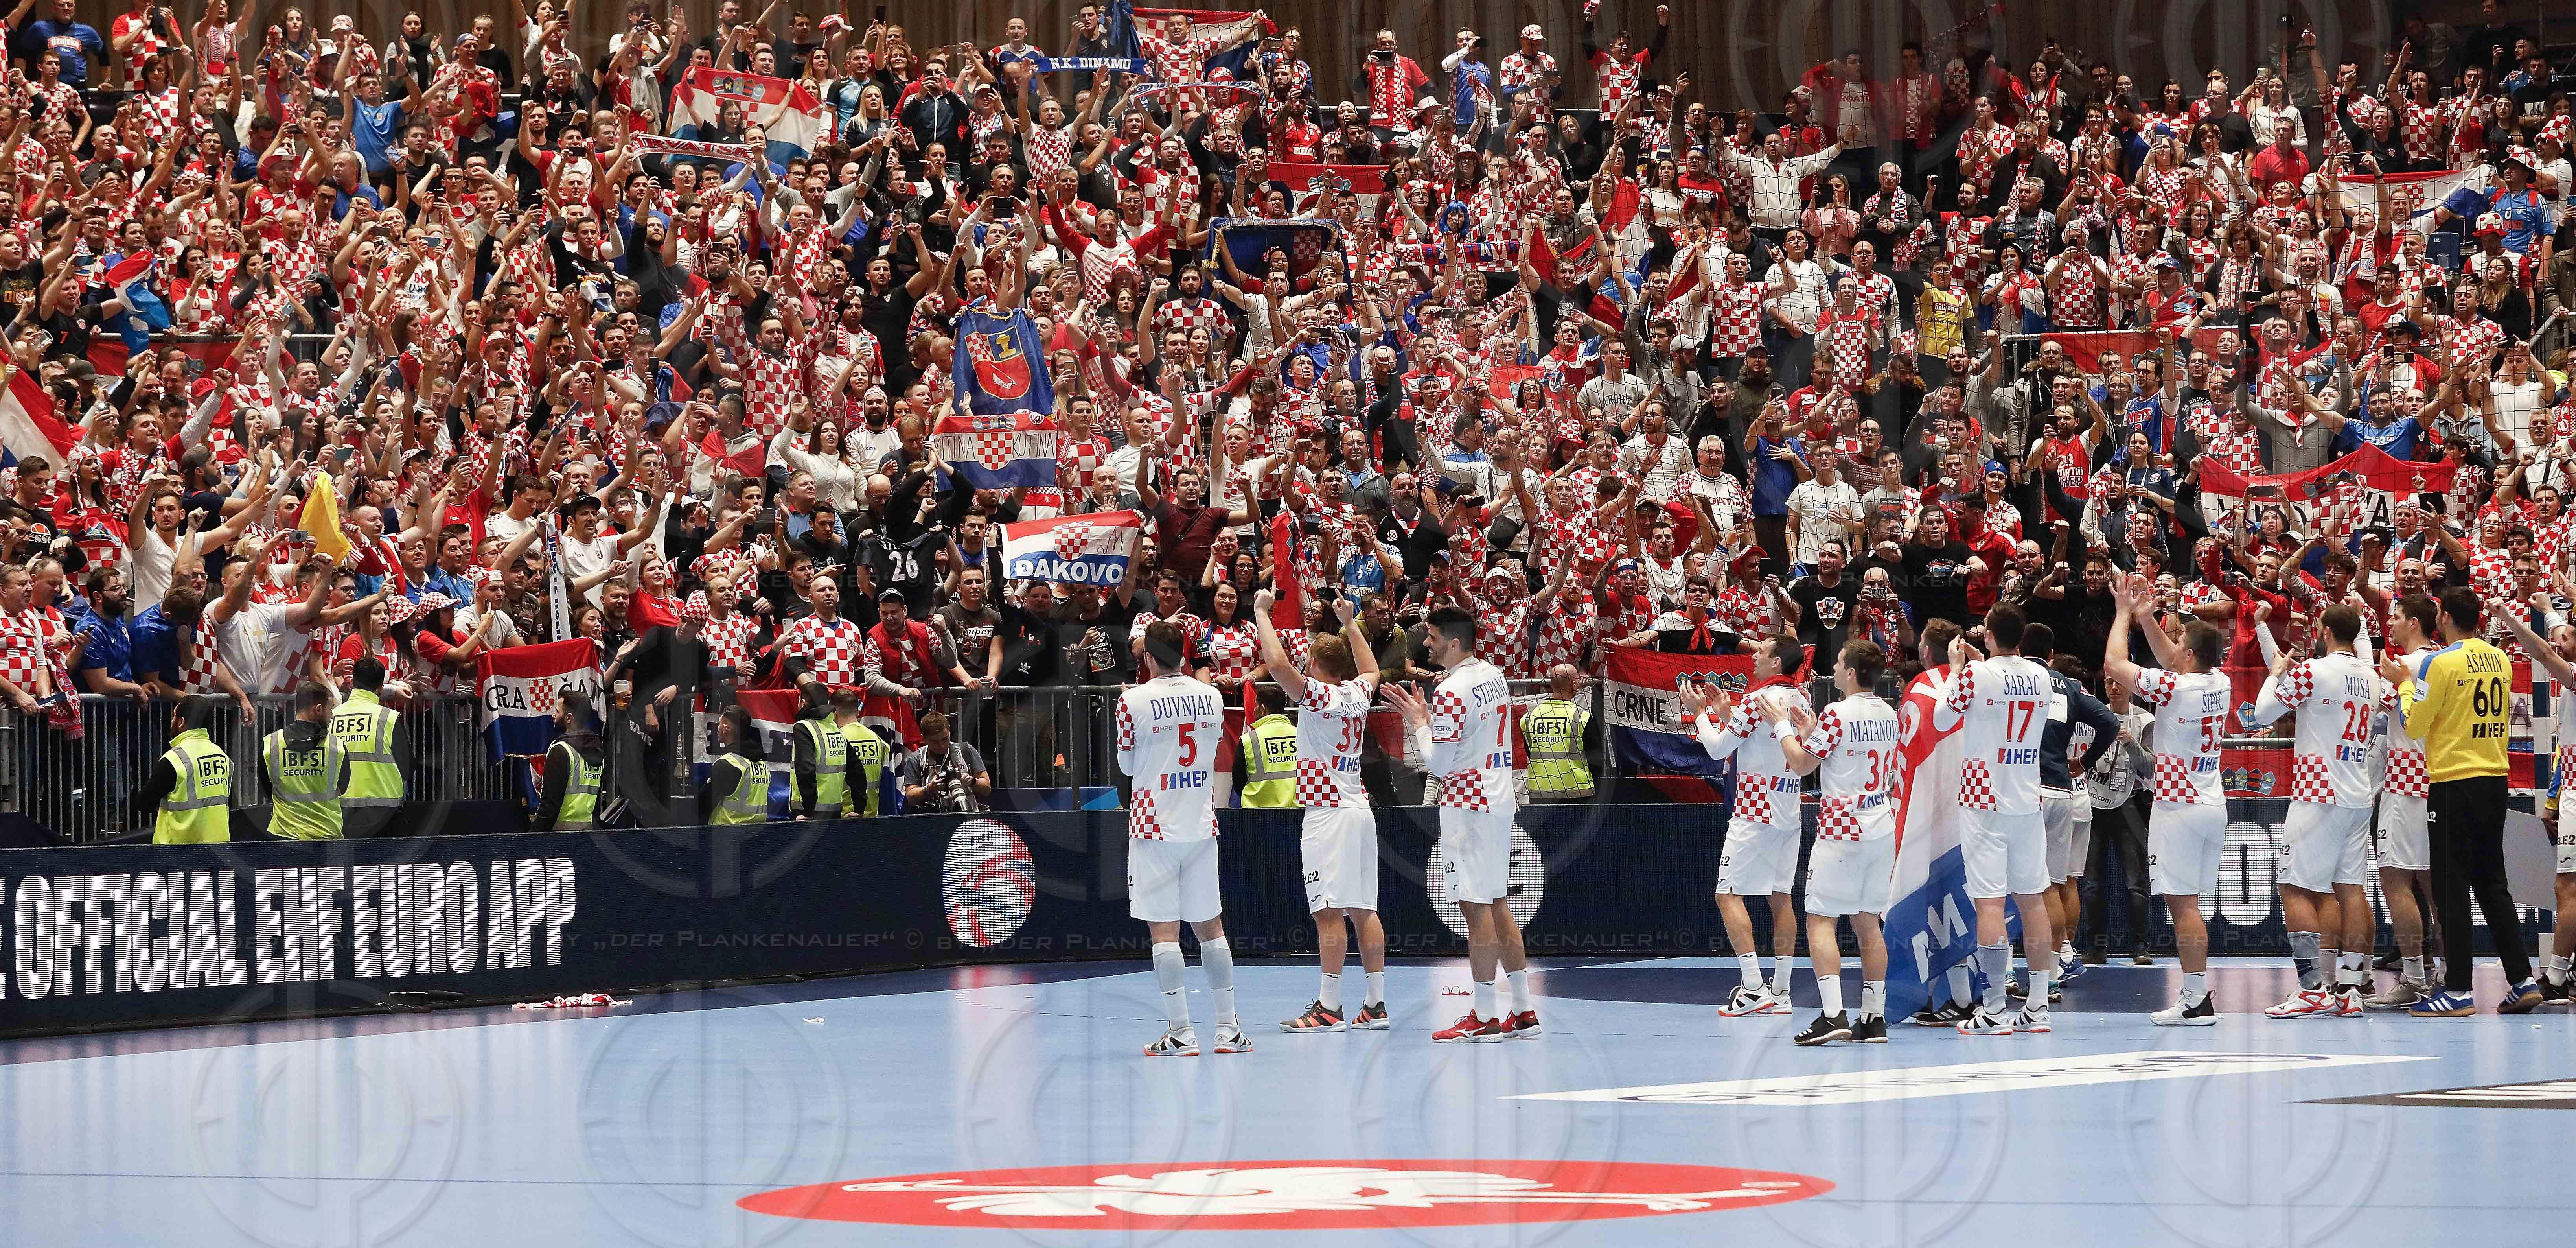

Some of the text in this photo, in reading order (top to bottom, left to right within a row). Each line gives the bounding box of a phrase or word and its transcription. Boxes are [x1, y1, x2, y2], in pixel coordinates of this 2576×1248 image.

[1051, 57, 1131, 70] N.K. DINAMO
[888, 551, 920, 582] 26
[1014, 560, 1126, 583] ĐAKOVO
[2344, 675, 2370, 699] MUSA
[2473, 677, 2502, 718] 60
[1150, 695, 1215, 722] DUVNJAK
[1614, 690, 1668, 725] CRNE
[336, 717, 365, 734] BFS
[1537, 722, 1561, 735] BFS
[2007, 701, 2036, 743] 17
[2342, 700, 2370, 743] 28
[339, 734, 370, 743] CURITY
[1337, 717, 1362, 753] 39
[2488, 723, 2505, 738] HEP
[831, 736, 844, 749] BFS
[855, 745, 875, 757] BFS
[1178, 722, 1198, 767] 5
[1271, 741, 1297, 755] BFS
[289, 752, 319, 767] BFS
[1268, 755, 1297, 763] SECURIT
[2013, 748, 2038, 764] HEP
[203, 760, 226, 777] BFS
[1179, 770, 1207, 788] HEP
[1786, 778, 1800, 793] HE
[15, 857, 577, 999] OFFICIAL EHF EURO APP
